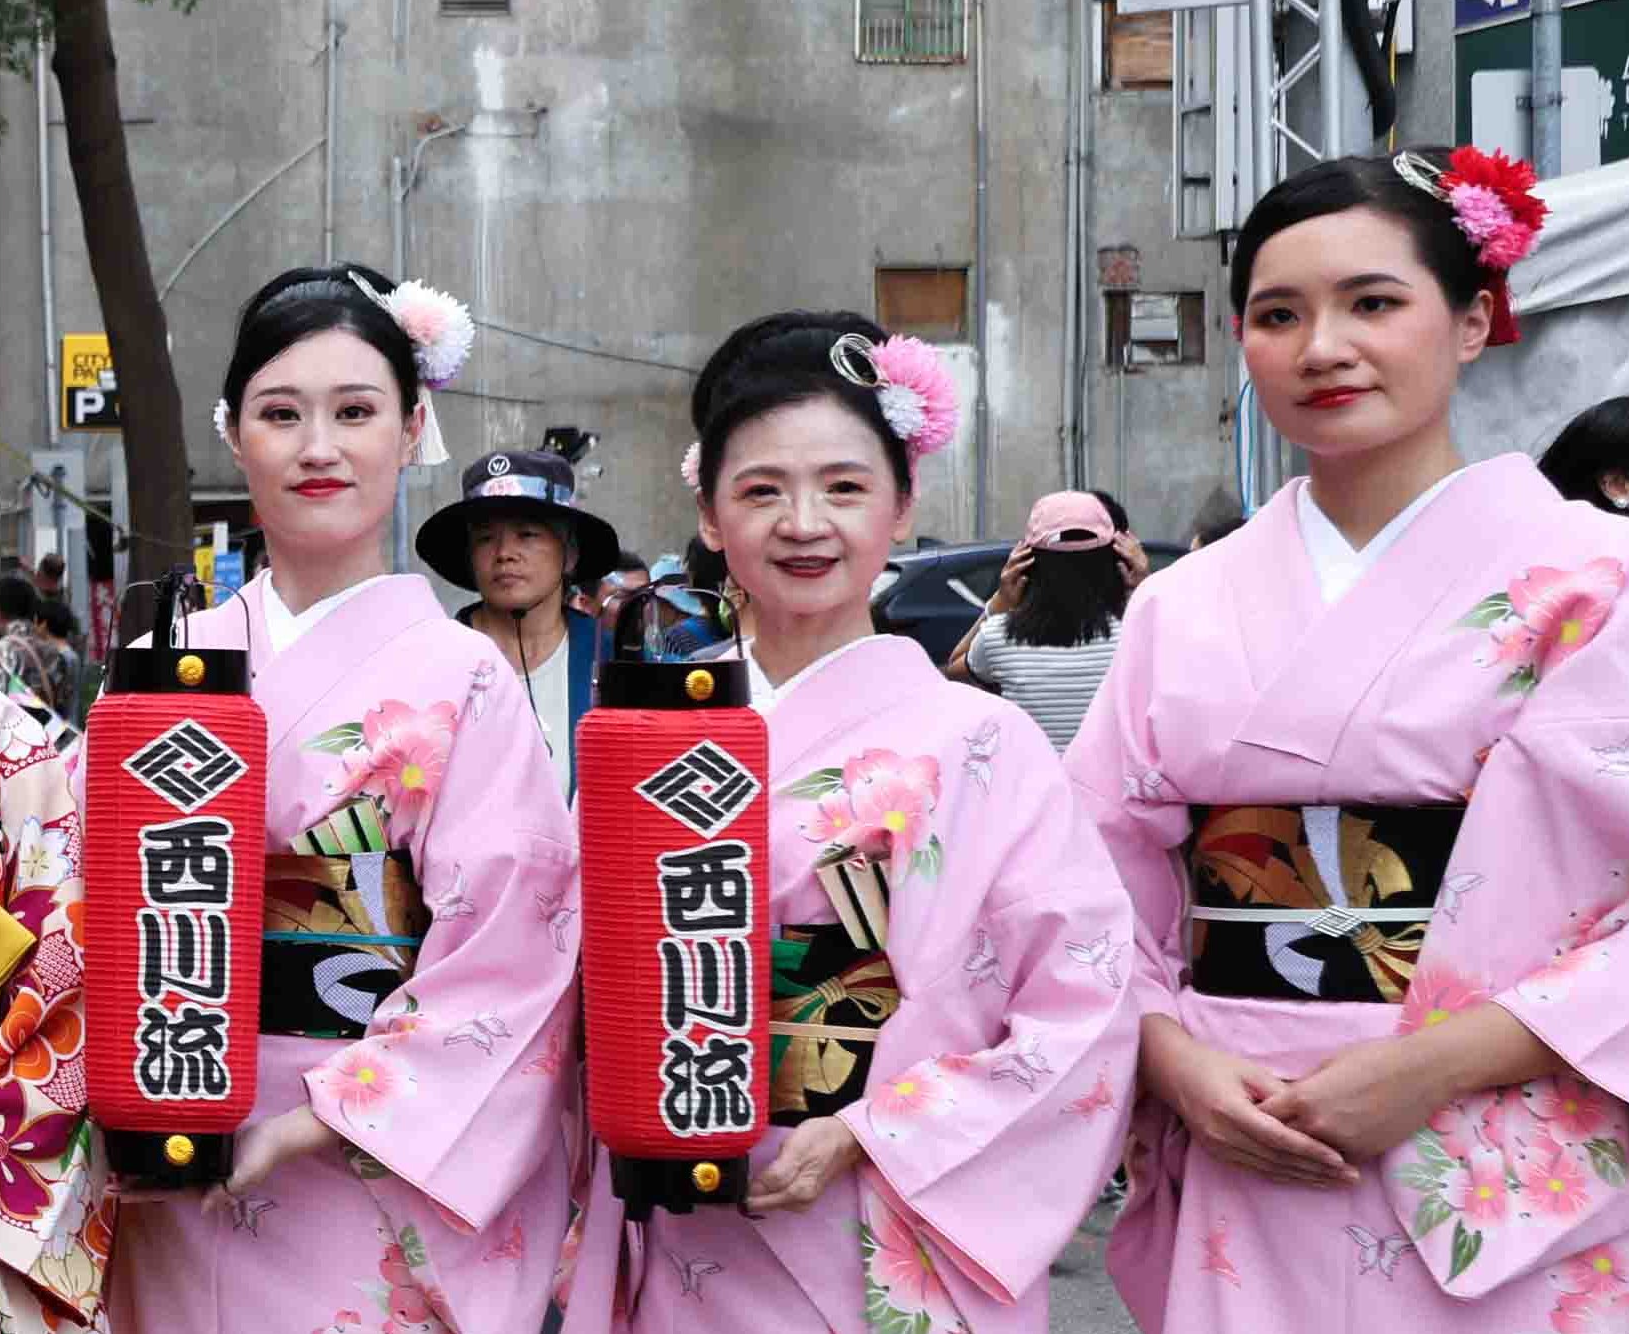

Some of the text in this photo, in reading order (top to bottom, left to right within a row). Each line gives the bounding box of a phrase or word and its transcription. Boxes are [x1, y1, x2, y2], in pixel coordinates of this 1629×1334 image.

[73, 354, 110, 366] CITY
[75, 391, 105, 424] P
[134, 816, 235, 1101] 西川流
[655, 839, 755, 1137] 西川流
